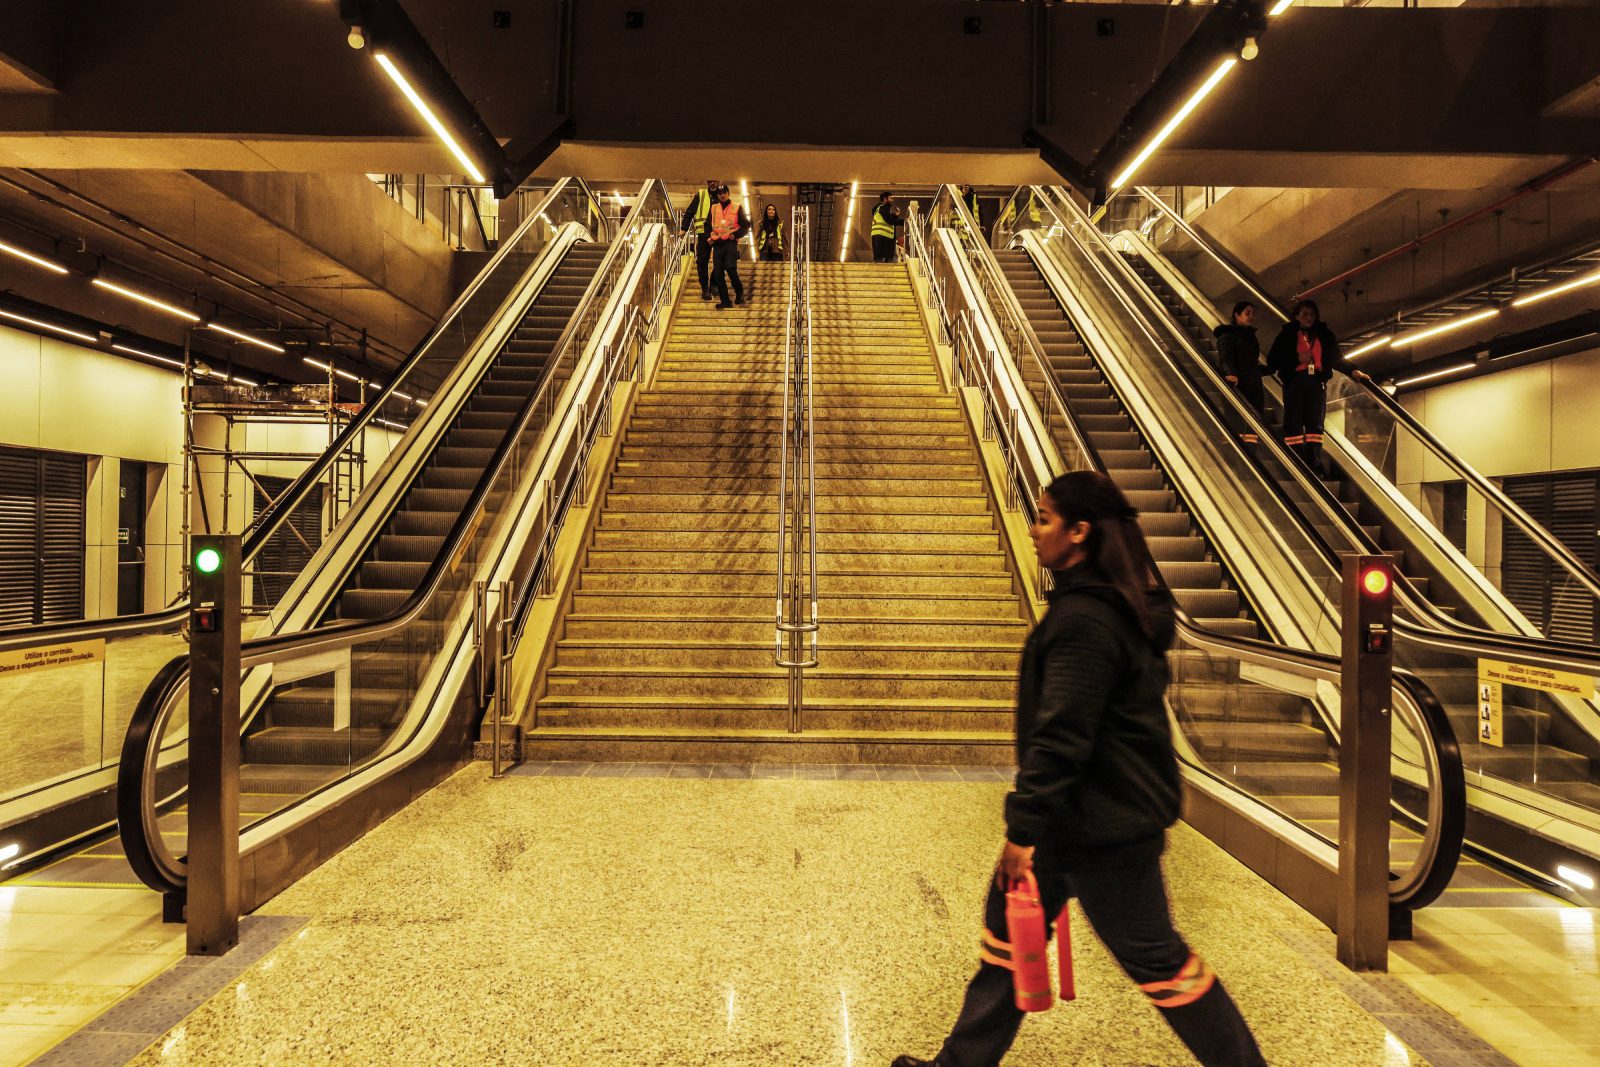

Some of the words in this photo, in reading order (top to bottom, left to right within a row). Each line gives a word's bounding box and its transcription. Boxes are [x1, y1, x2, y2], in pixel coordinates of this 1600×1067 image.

[25, 652, 43, 660] Utilize
[21, 660, 45, 669] esquerda
[58, 656, 70, 664] para
